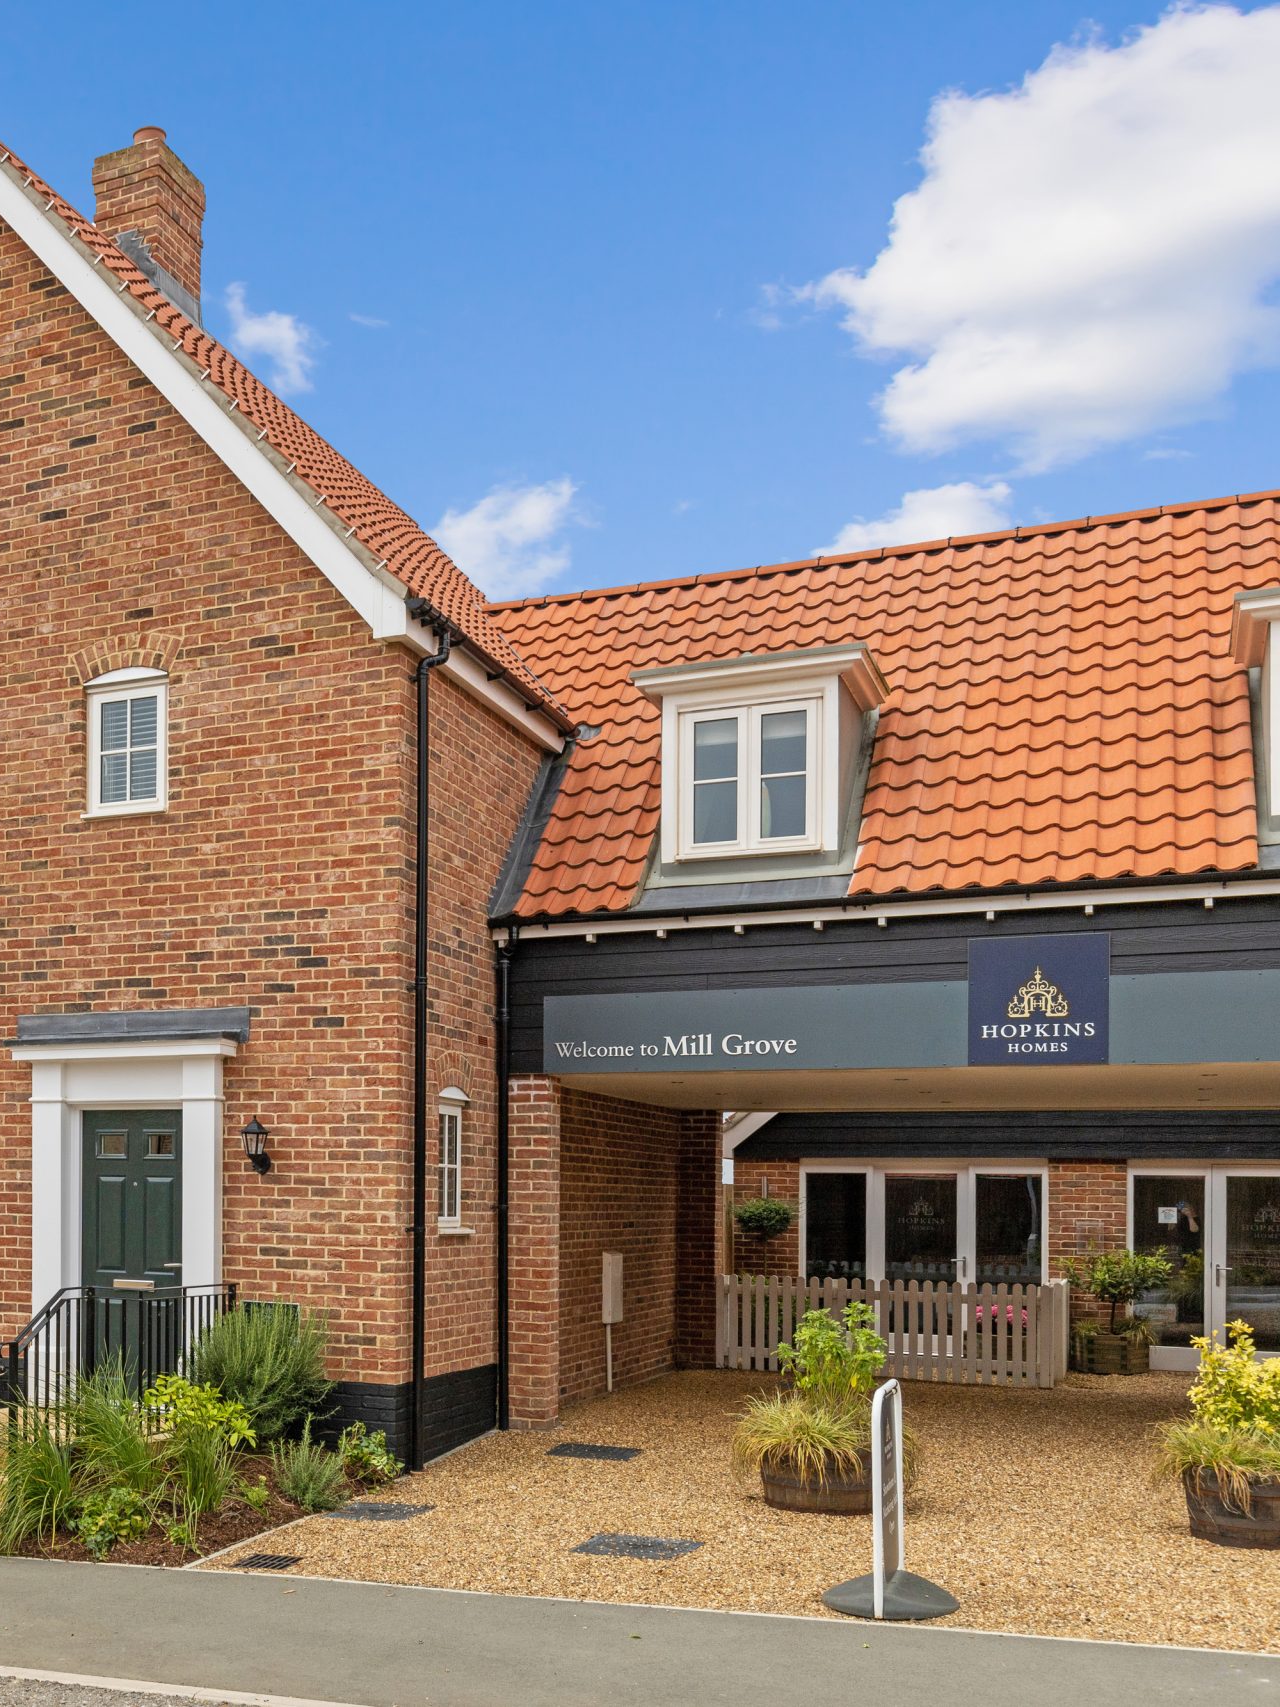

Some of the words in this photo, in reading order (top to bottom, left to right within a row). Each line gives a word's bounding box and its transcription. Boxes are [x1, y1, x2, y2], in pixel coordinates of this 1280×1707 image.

[981, 1022, 1096, 1038] HOPKINS
[554, 1041, 634, 1058] Welcome
[640, 1043, 659, 1057] to
[662, 1033, 714, 1057] Mill
[721, 1033, 798, 1056] Grove
[1007, 1042, 1068, 1053] HOMES
